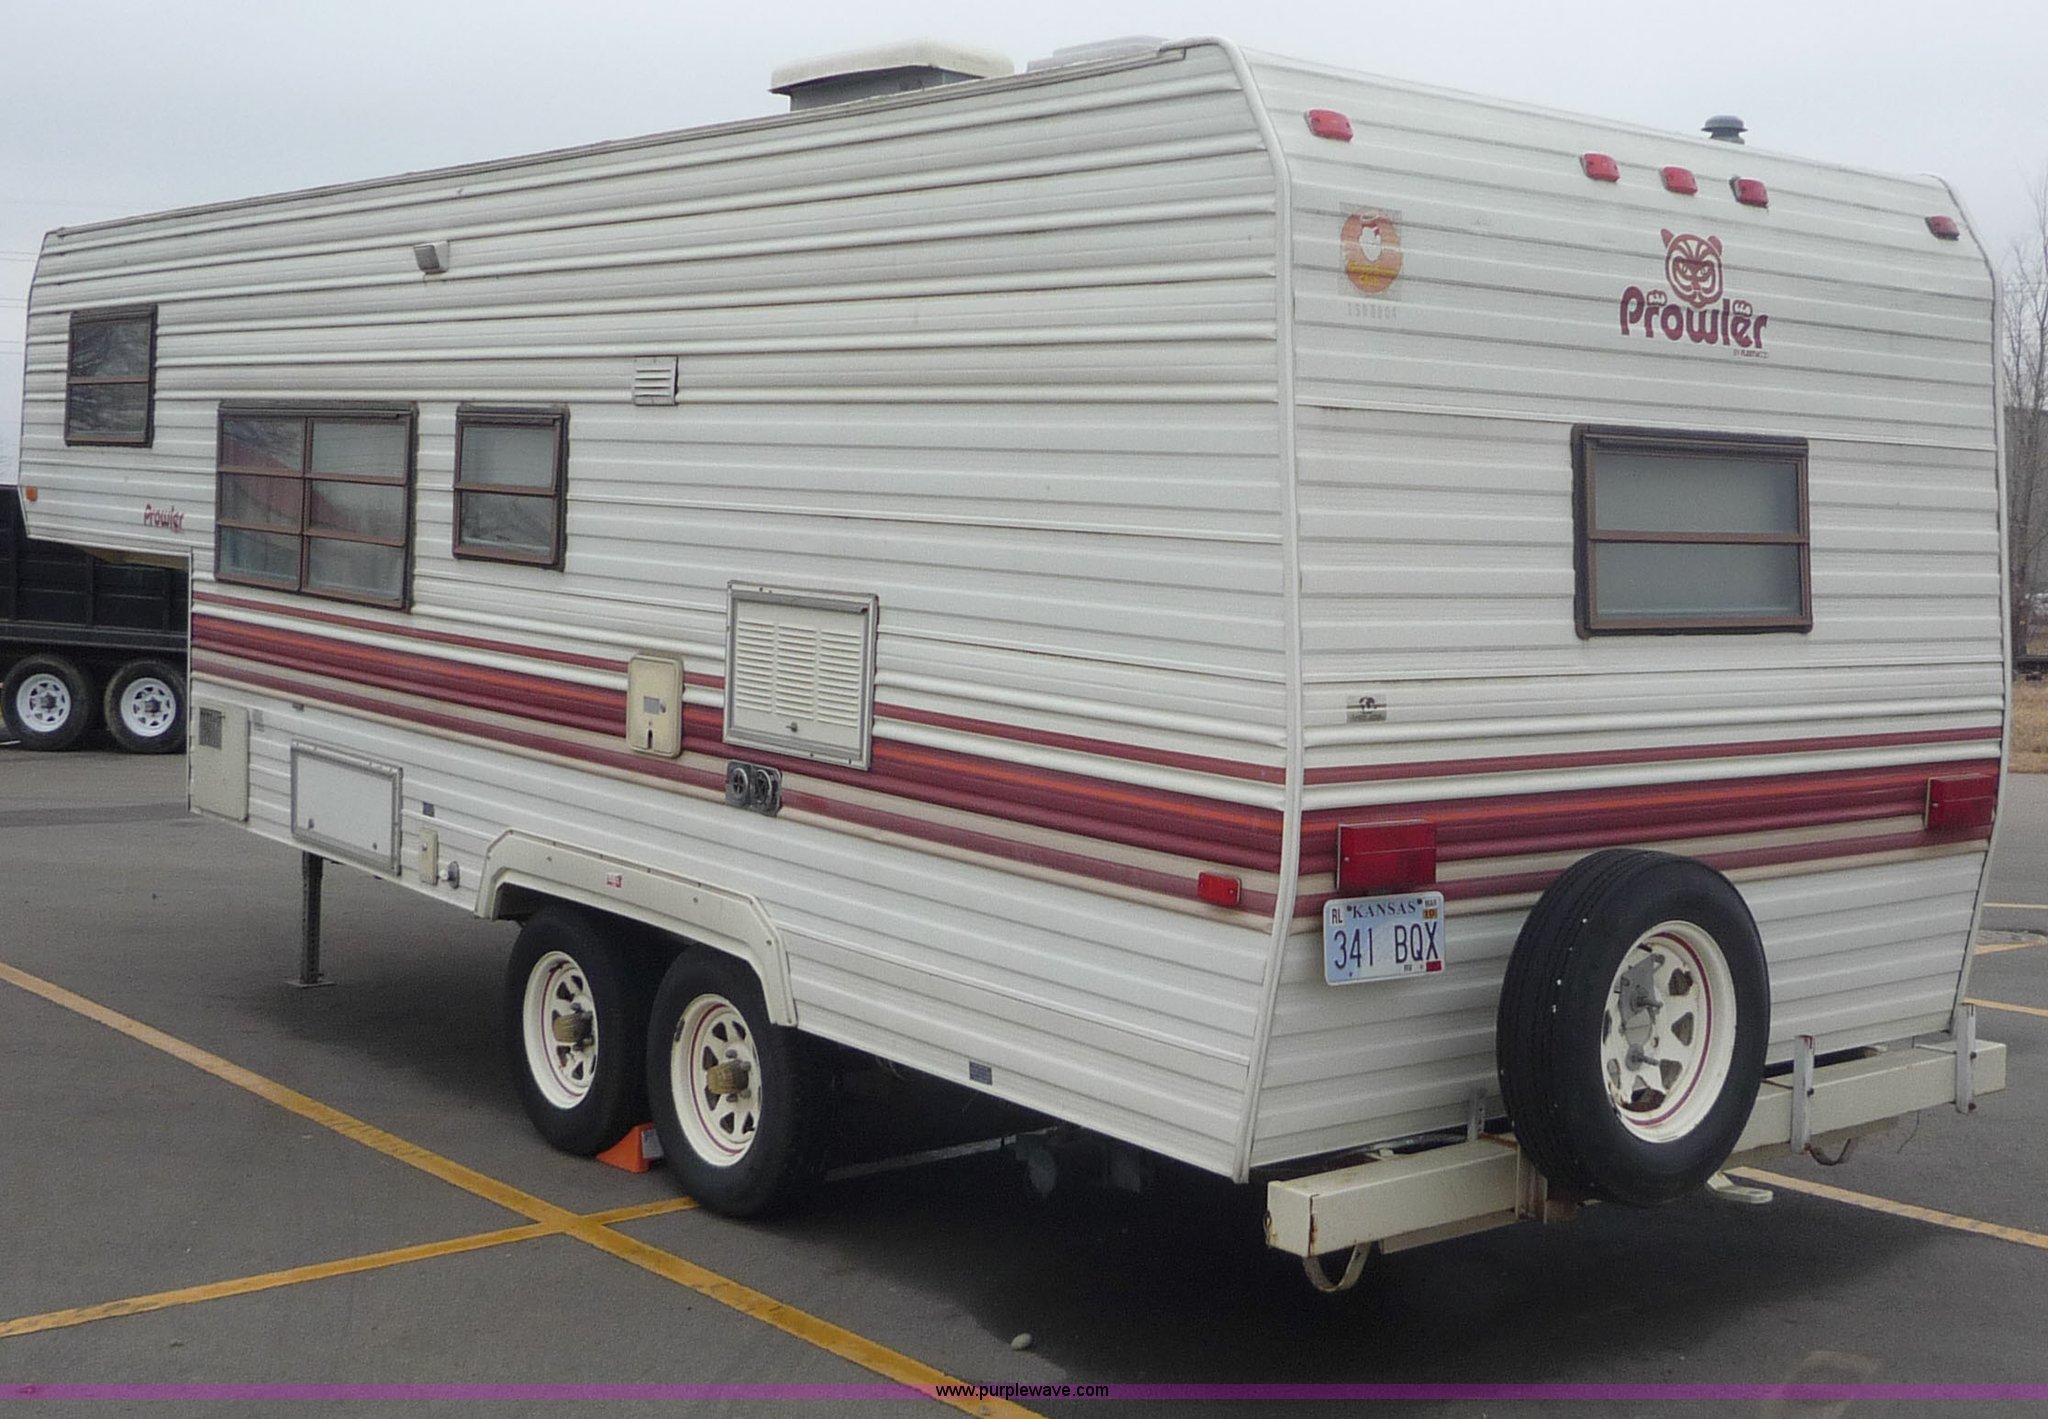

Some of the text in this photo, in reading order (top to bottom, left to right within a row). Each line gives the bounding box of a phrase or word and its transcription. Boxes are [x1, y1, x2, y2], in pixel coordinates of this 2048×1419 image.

[1620, 286, 1769, 349] Prowler
[144, 503, 184, 531] Prowler
[1353, 901, 1416, 919] KANSAS
[1334, 921, 1439, 969] 341 BQX
